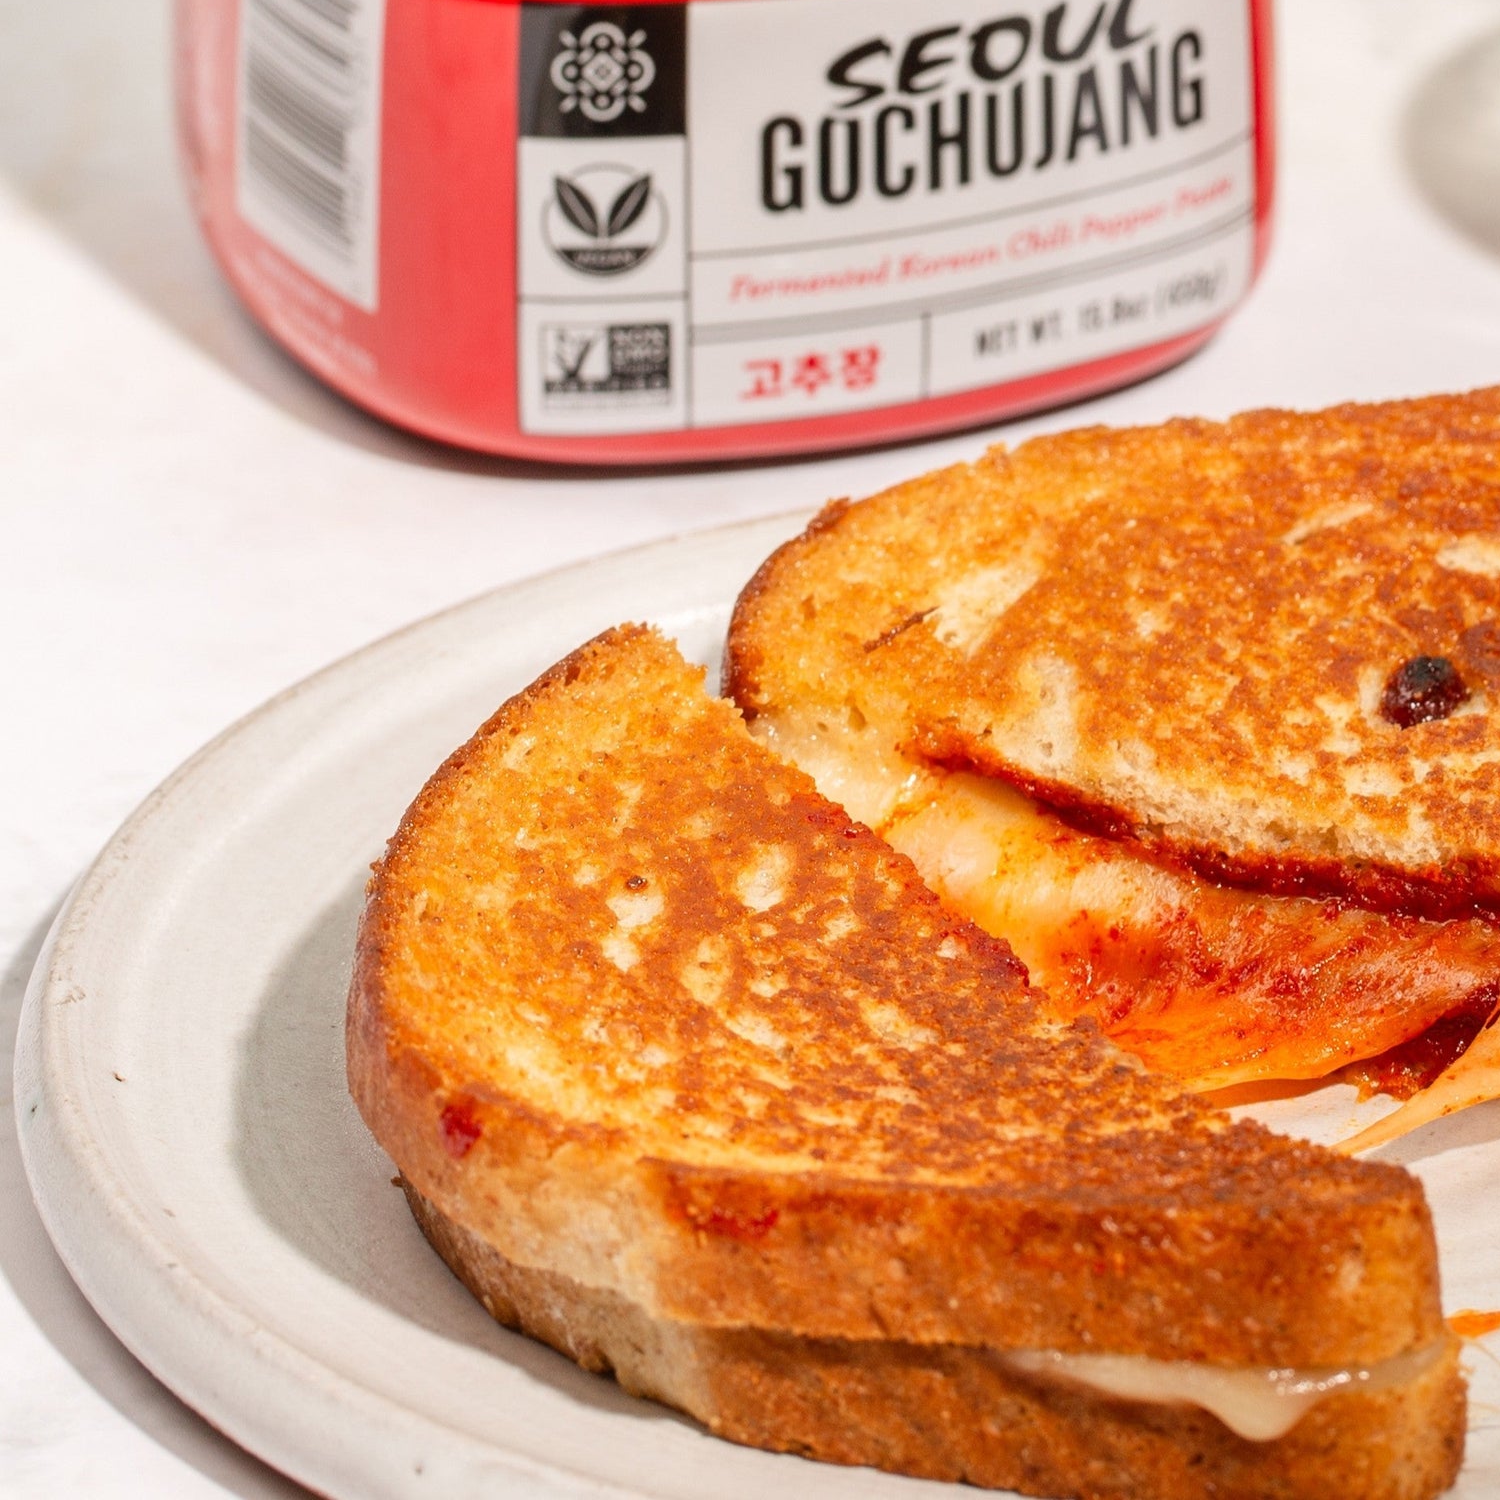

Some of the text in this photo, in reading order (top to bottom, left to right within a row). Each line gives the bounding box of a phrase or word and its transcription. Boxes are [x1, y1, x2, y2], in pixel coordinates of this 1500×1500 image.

[760, 30, 1206, 214] GOCHUJANG
[899, 245, 999, 280] Korean
[739, 342, 882, 402] 고추장
